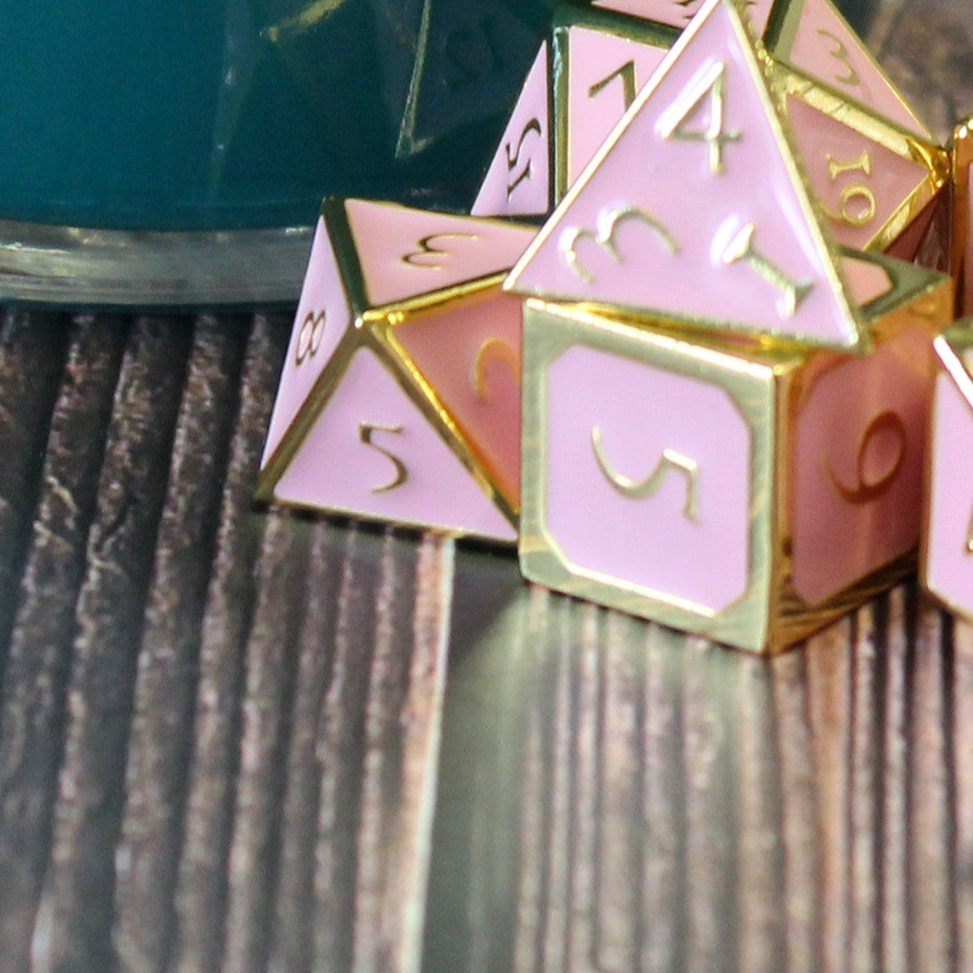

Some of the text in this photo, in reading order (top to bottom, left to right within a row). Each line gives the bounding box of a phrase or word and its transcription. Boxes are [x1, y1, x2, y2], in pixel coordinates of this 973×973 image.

[817, 27, 860, 87] 3
[655, 58, 743, 174] 4
[504, 117, 542, 203] 15
[399, 232, 480, 272] 3
[558, 205, 680, 286] 3
[720, 216, 818, 318] 1
[294, 310, 327, 369] 8
[358, 420, 409, 495] 5
[590, 423, 703, 527] 5
